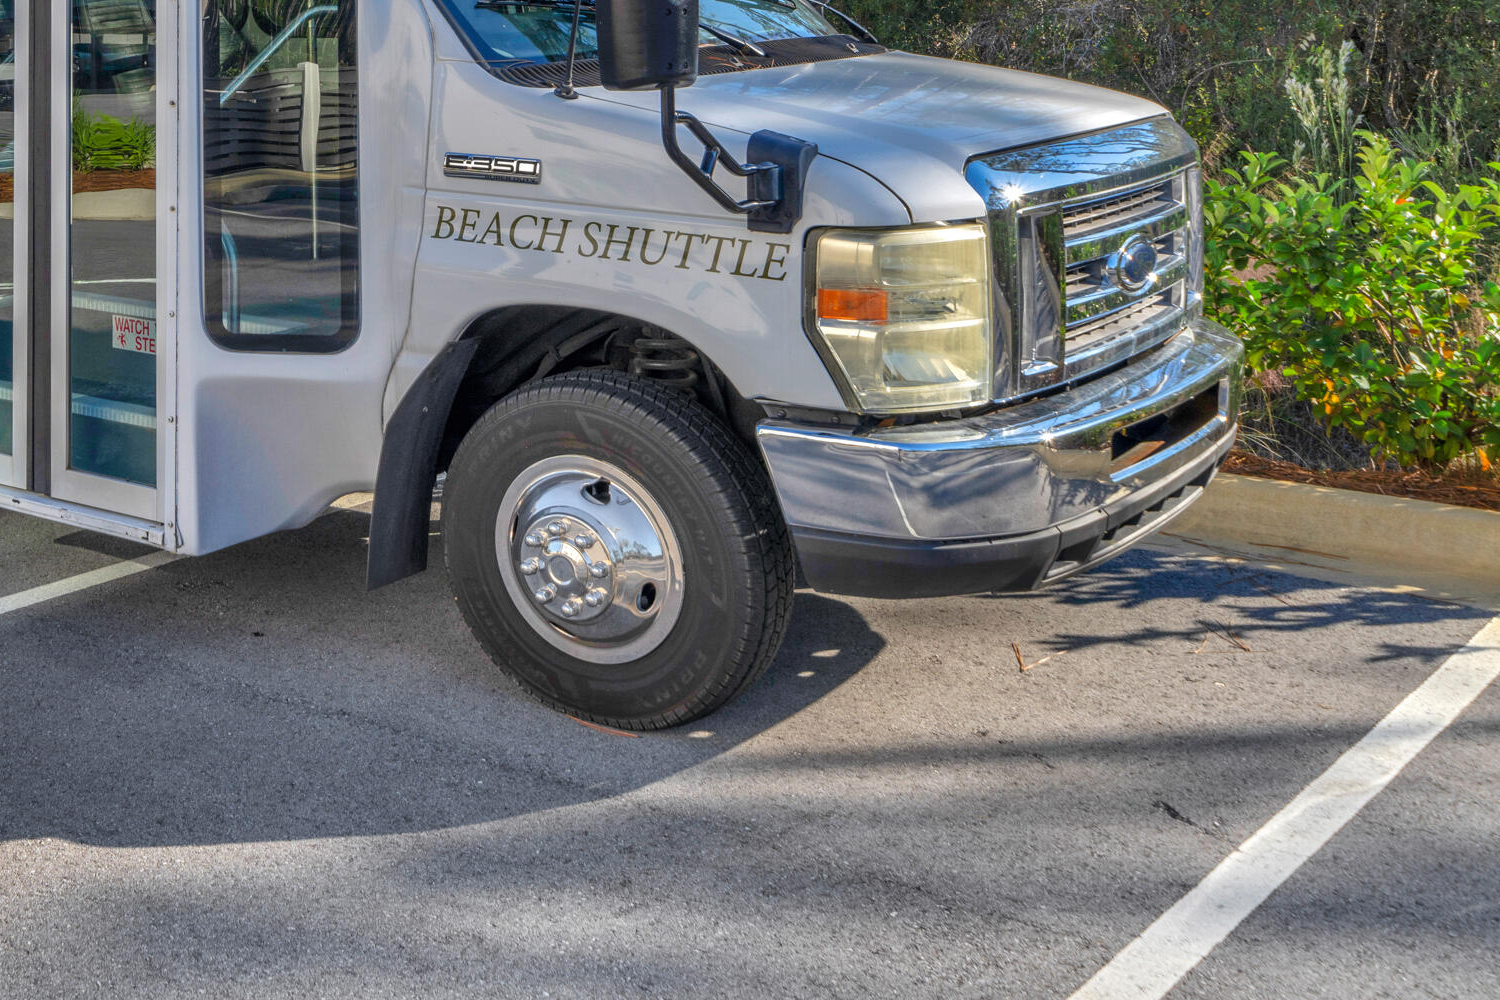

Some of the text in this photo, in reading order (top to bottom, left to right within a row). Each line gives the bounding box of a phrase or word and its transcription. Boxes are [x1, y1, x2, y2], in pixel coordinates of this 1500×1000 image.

[430, 205, 790, 281] BEACH SHUTTLE
[114, 316, 150, 337] WATCH
[135, 336, 157, 353] STE
